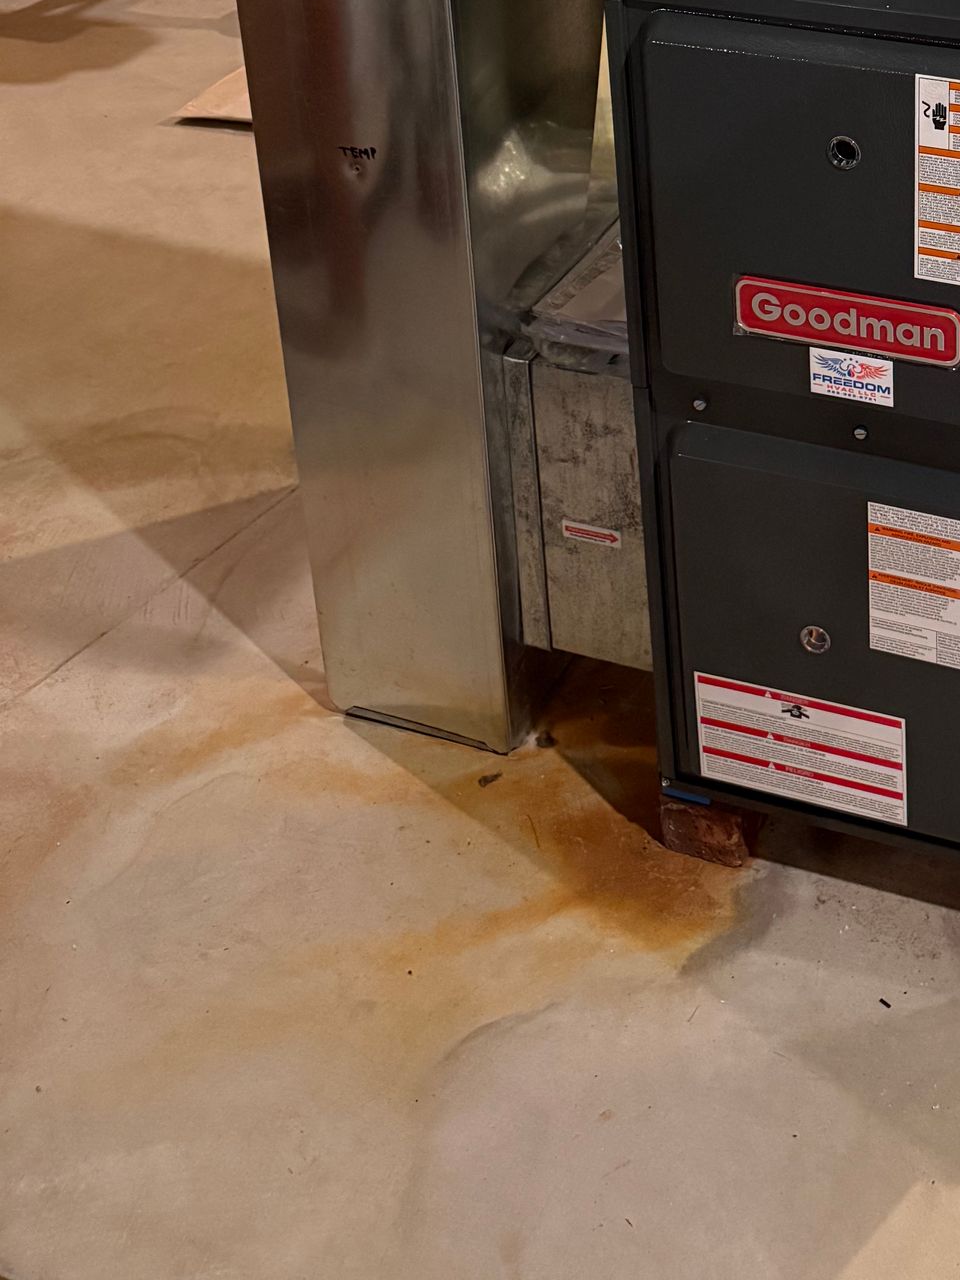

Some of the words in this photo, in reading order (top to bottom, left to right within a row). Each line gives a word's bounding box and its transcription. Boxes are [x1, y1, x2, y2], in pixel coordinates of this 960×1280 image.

[338, 145, 377, 160] TEMP
[751, 292, 945, 351] Goodman
[812, 373, 891, 395] FREEDOM
[827, 384, 854, 393] HVAC
[858, 390, 877, 398] LLC
